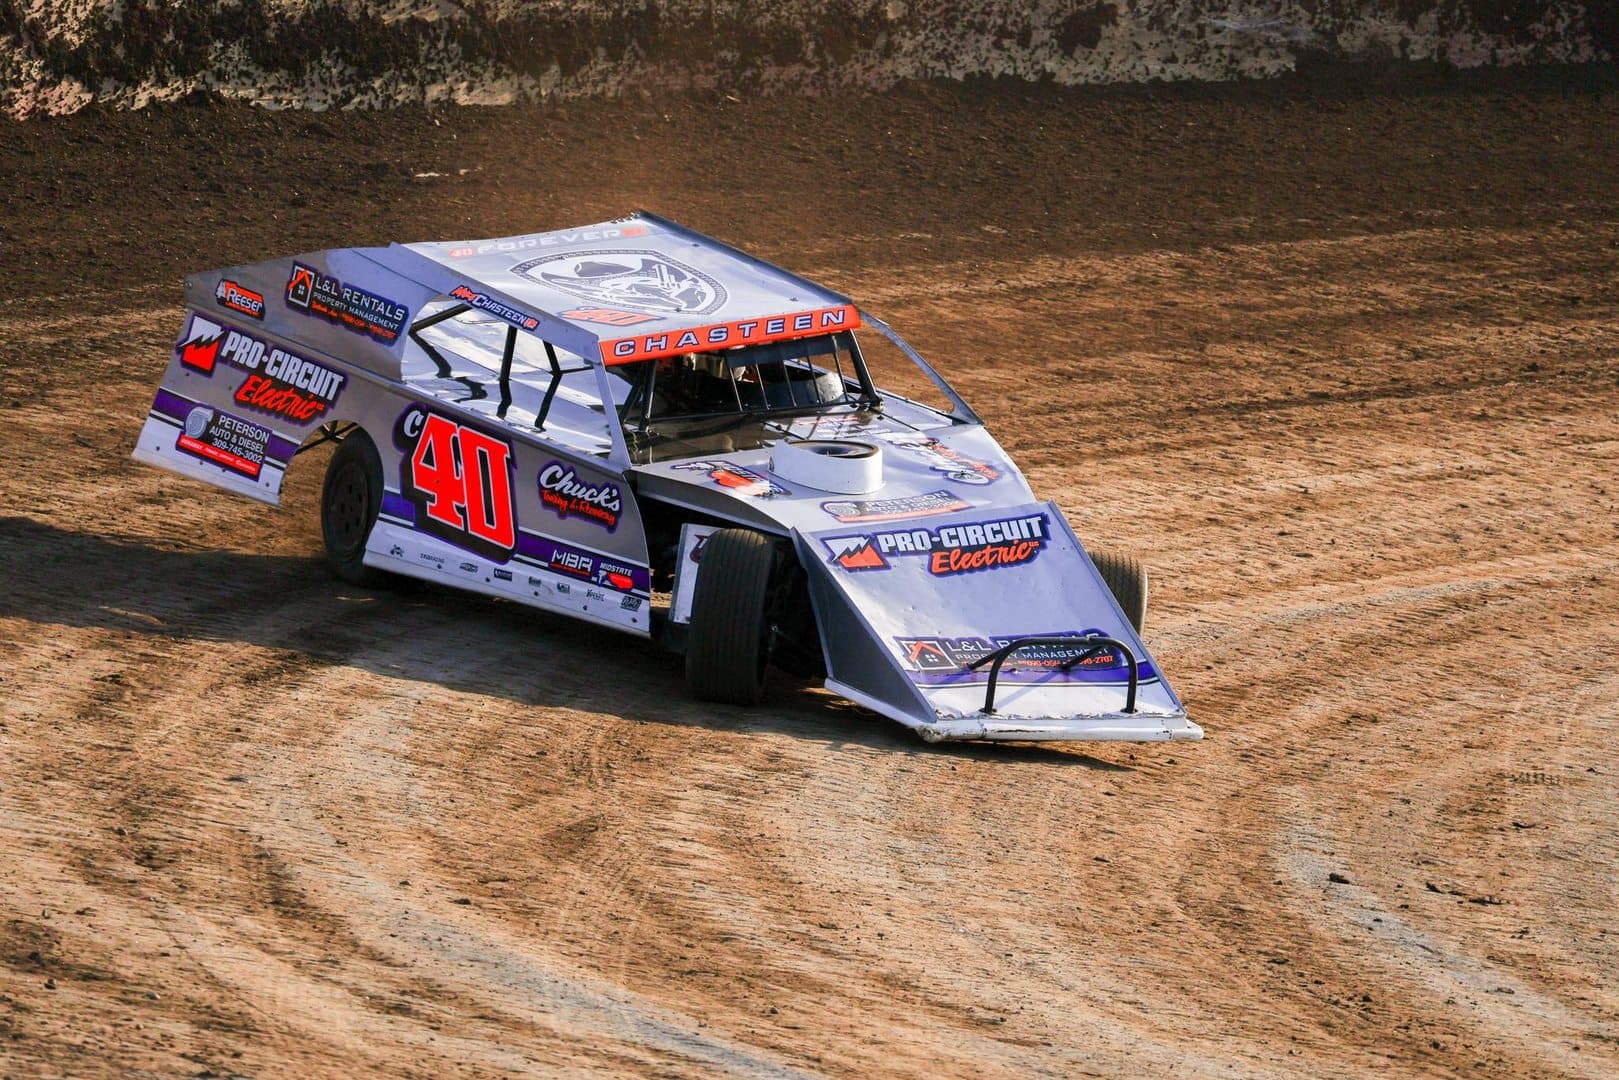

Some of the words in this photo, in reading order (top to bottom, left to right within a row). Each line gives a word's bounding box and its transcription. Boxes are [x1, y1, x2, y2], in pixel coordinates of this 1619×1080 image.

[477, 229, 620, 254] FOREVER
[313, 292, 347, 310] PROPERTY
[348, 306, 399, 330] MANAGEMENT
[315, 277, 338, 296] L&L
[342, 287, 405, 320] RENTALS
[472, 294, 526, 325] CHASTEEN
[614, 310, 846, 357] CHASTEEN
[236, 375, 318, 419] Electric
[209, 425, 231, 441] AUTO
[238, 437, 264, 454] DIESEL
[218, 415, 270, 443] PETERSON
[211, 438, 263, 464] 309-745-3002
[412, 413, 515, 550] 40
[540, 464, 620, 511] Chuck's
[551, 550, 593, 573] MBR
[931, 540, 1032, 573] Electric
[946, 640, 992, 651] L&L
